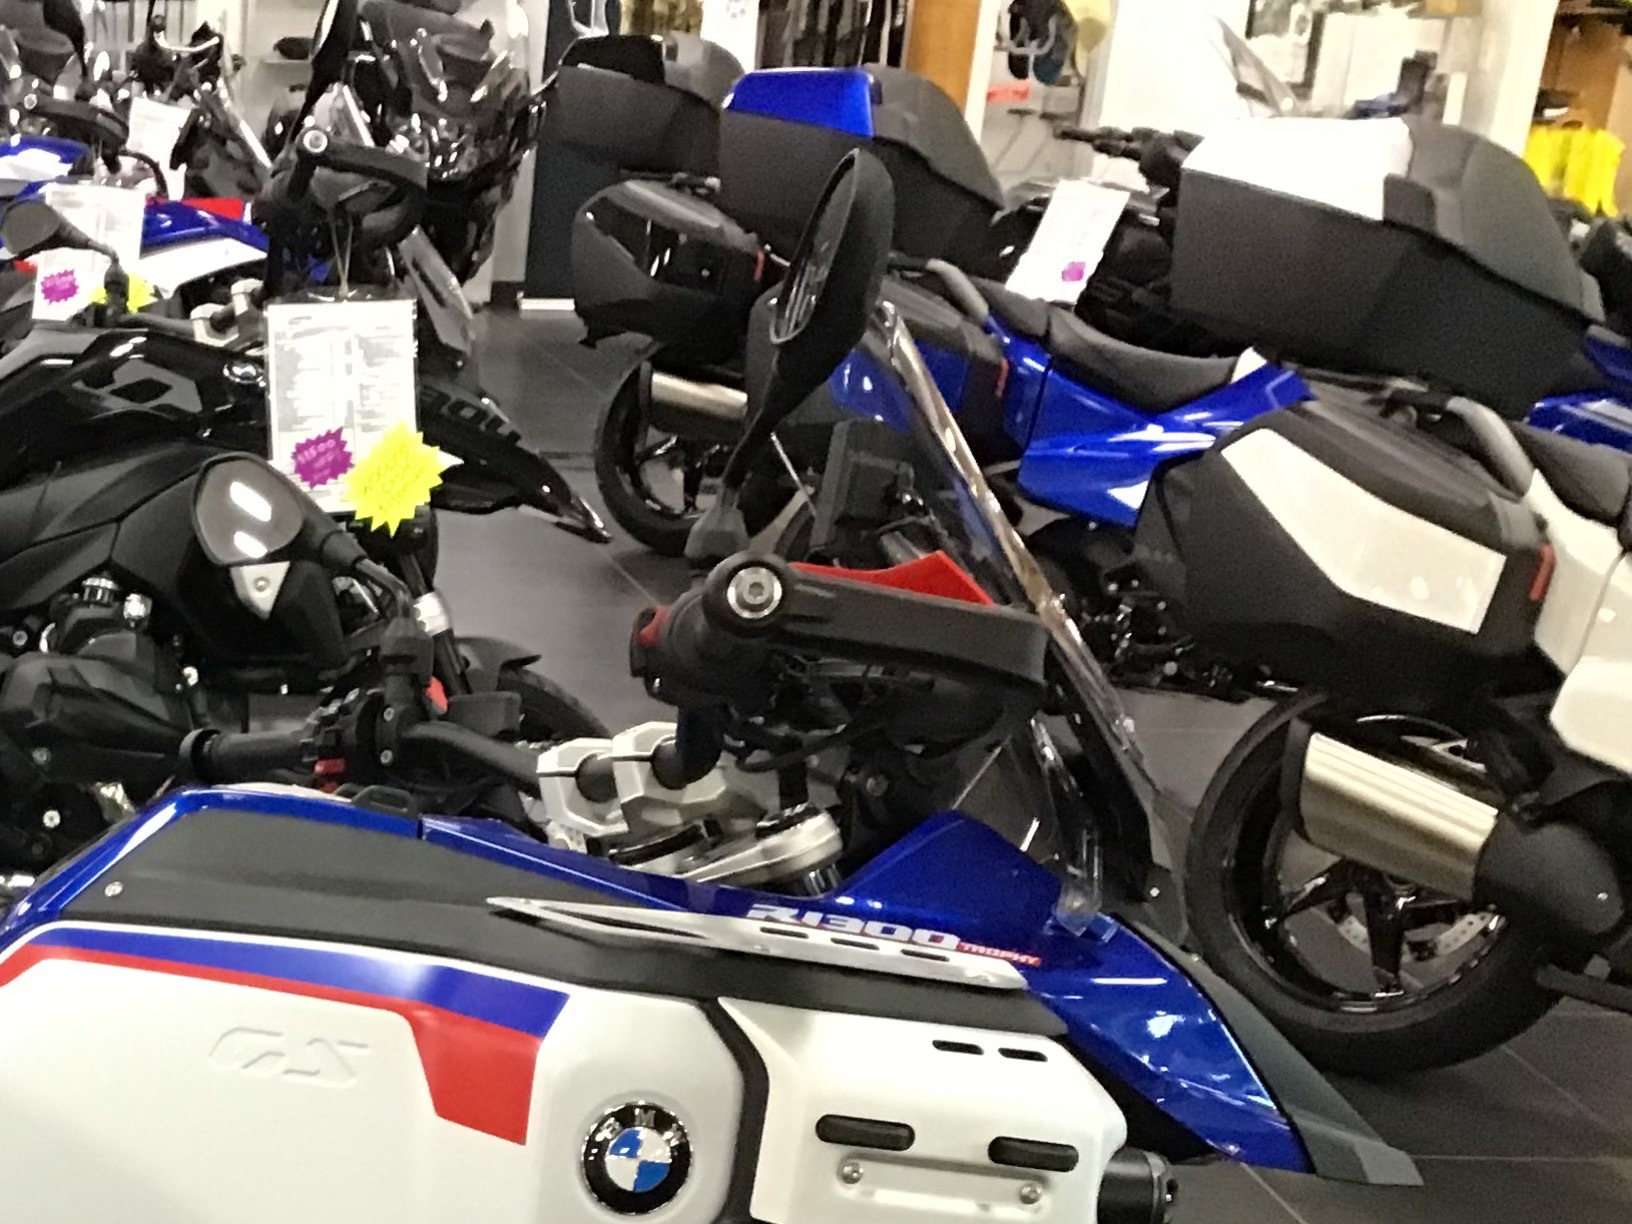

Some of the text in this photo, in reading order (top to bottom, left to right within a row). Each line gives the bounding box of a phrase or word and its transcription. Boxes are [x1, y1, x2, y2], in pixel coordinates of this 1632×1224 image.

[746, 903, 1039, 967] R1300 TROPHY
[206, 1026, 371, 1089] GS
[594, 1107, 688, 1148] BMW
